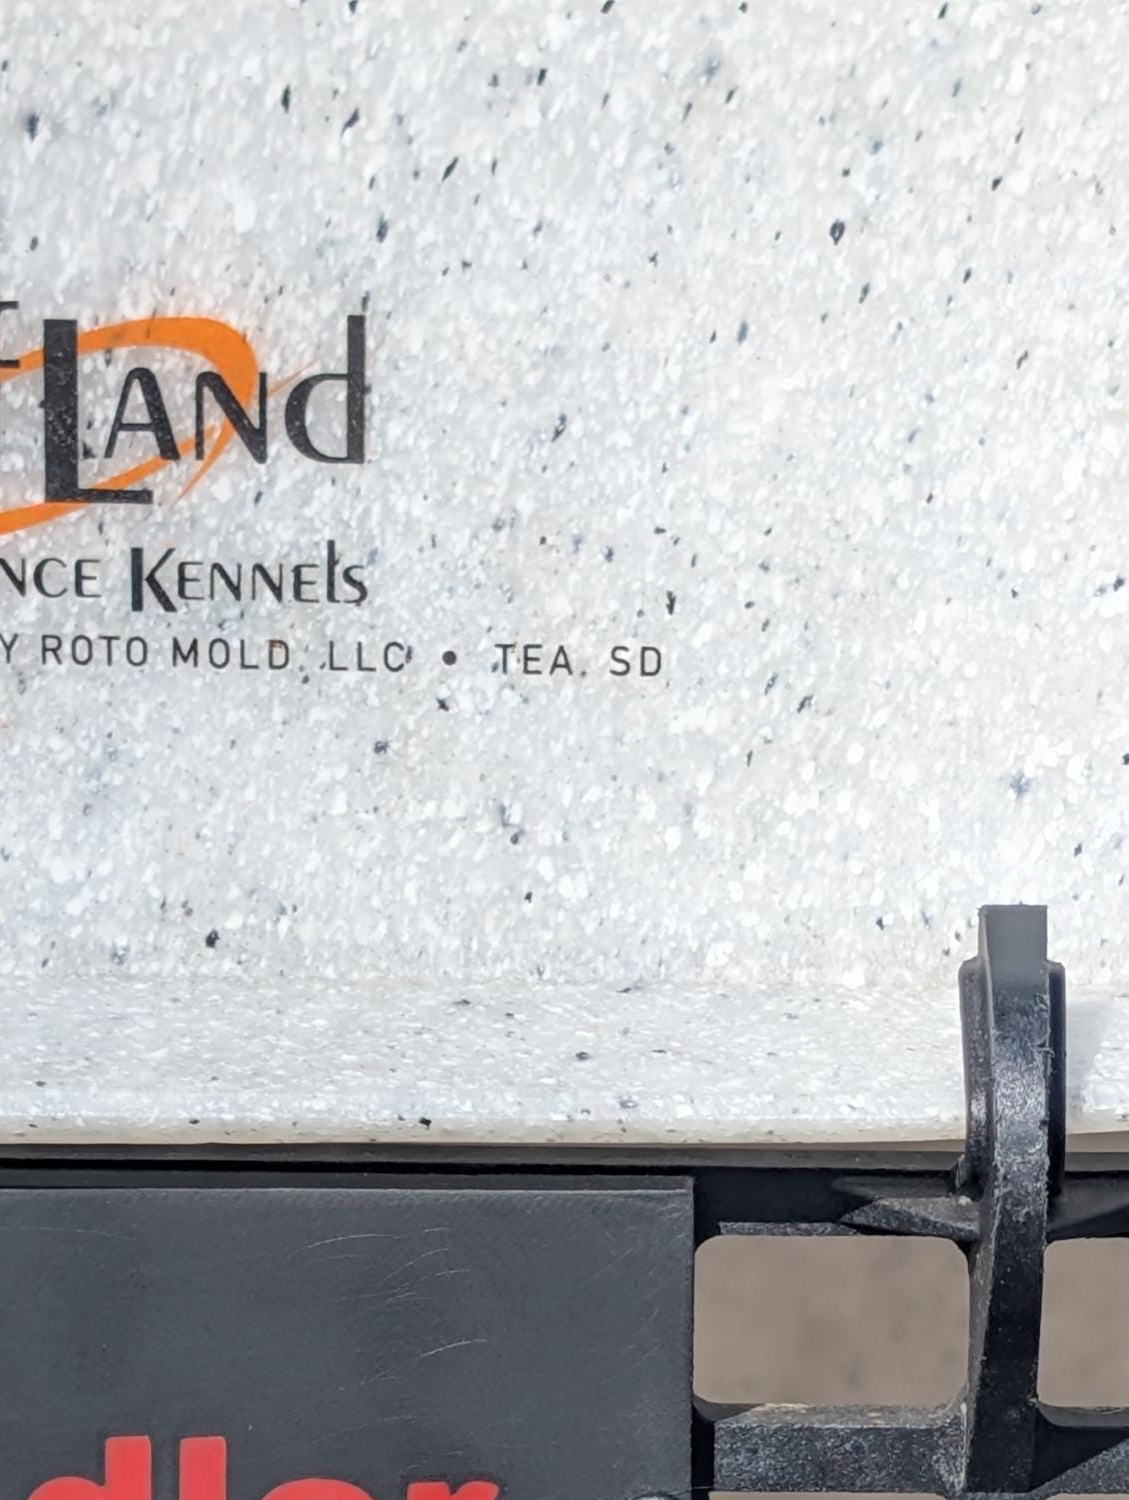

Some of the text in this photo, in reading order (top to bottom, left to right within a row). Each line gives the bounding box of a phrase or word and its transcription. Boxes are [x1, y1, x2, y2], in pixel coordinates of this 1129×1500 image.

[41, 634, 150, 667] ROTO
[329, 640, 405, 673] LLC
[609, 645, 663, 677] SD
